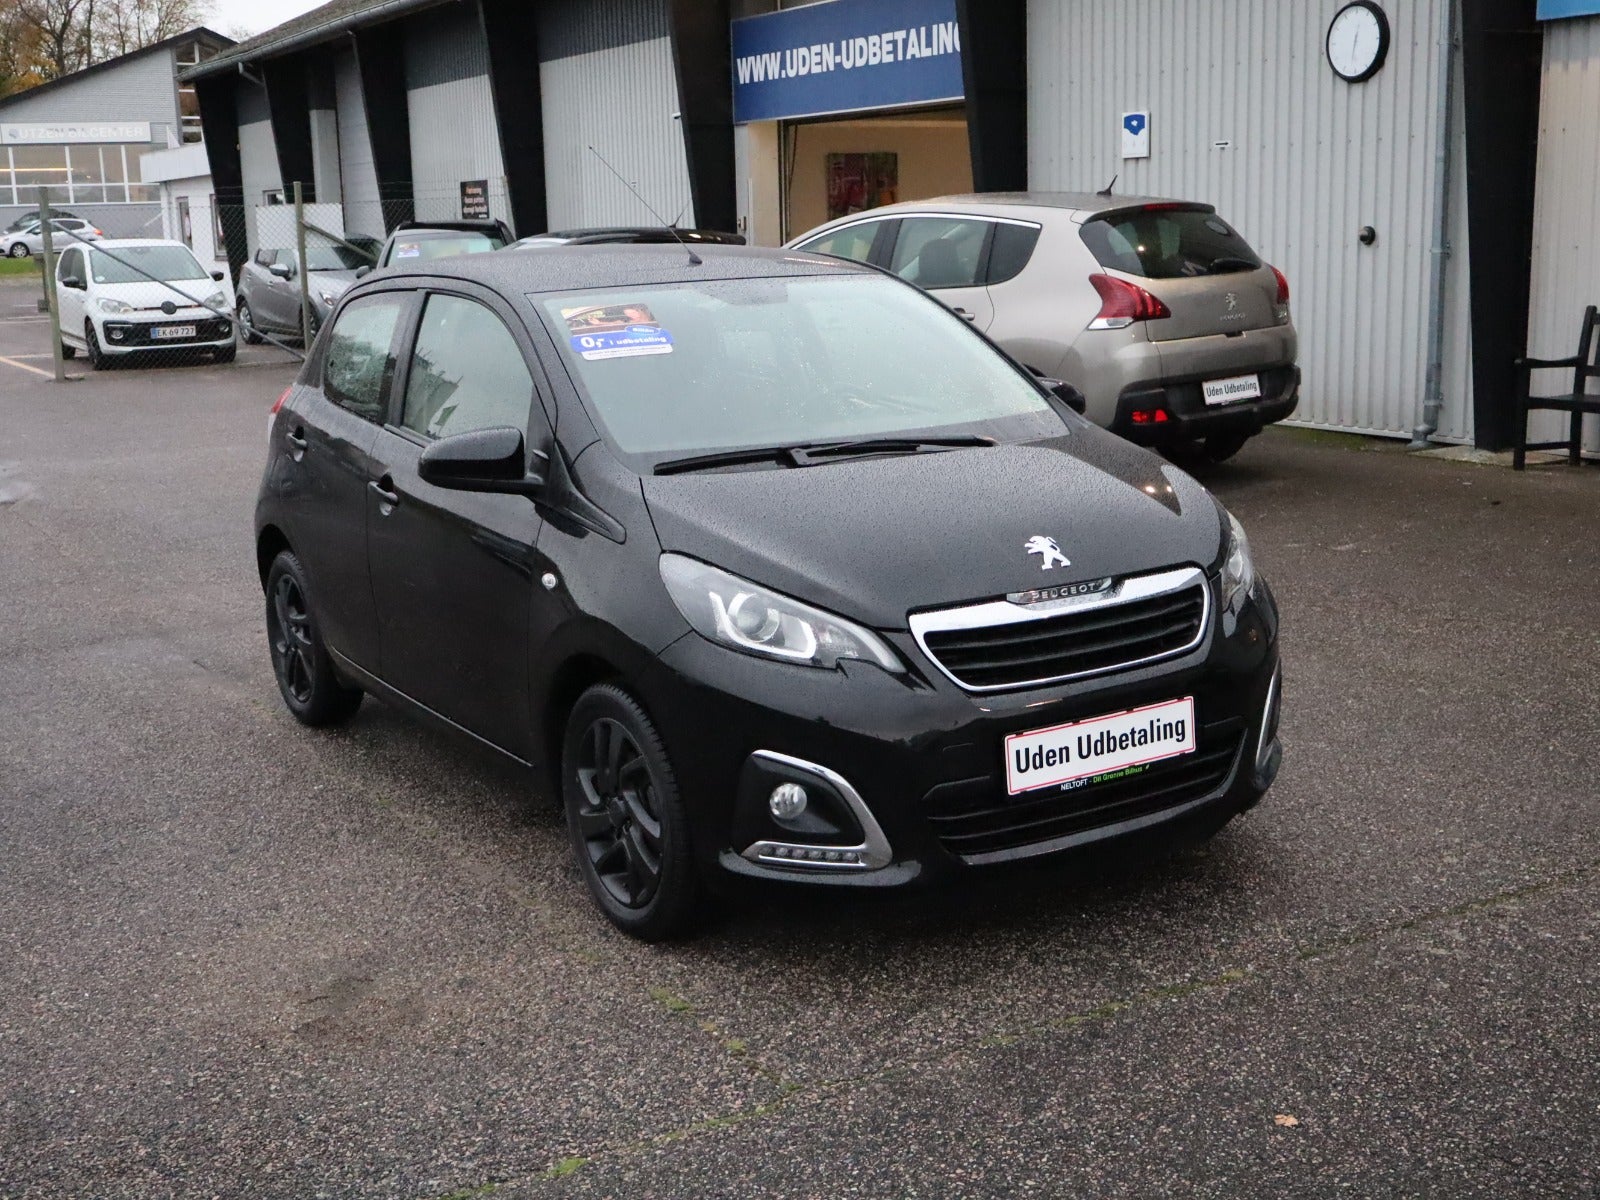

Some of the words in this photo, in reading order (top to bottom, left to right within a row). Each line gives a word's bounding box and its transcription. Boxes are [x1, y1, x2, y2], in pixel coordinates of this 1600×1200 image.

[157, 329, 167, 337] EK
[616, 336, 667, 345] udbetaling
[1206, 386, 1223, 397] Uden
[1224, 381, 1258, 395] Udbetaling
[1031, 583, 1096, 601] PEUGEOT
[1015, 744, 1070, 774] Uden
[1077, 718, 1186, 759] Udbetaling
[1060, 778, 1088, 791] NELTOFT
